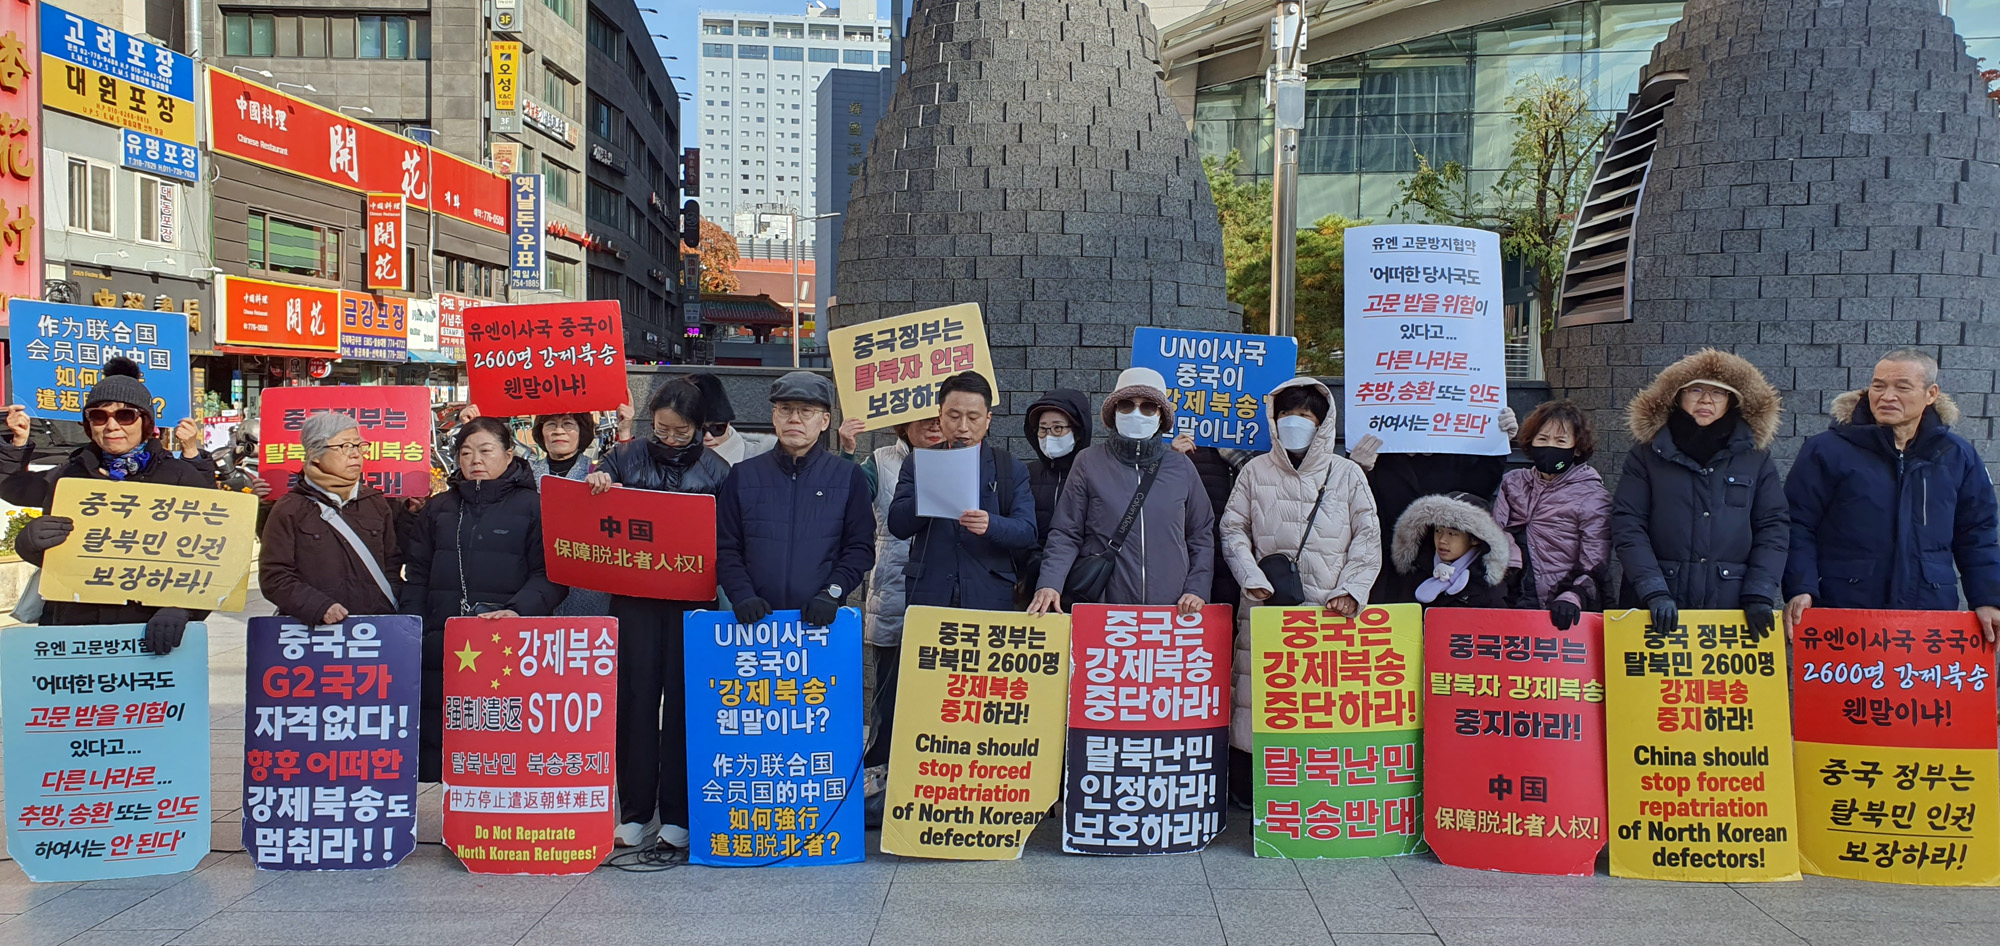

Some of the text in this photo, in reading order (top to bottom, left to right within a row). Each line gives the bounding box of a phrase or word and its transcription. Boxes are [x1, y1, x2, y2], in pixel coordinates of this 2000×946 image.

[500, 15, 510, 24] 3F
[64, 13, 174, 78] 고려포장
[498, 63, 512, 92] 오성
[65, 64, 175, 123] 대원포장
[236, 95, 288, 132] 中國料理
[500, 117, 509, 125] 3F
[126, 133, 196, 168] 유명포장
[237, 133, 289, 156] Chinese Restaurant
[374, 221, 397, 280] 開花
[1402, 236, 1476, 253] 고문방지협약
[513, 270, 539, 279] 제일사
[1423, 266, 1481, 285] 당사국도
[286, 297, 325, 336] 開花
[344, 298, 405, 331] 금강포장
[1362, 292, 1440, 313] 고문 받을
[38, 315, 157, 346] 作为联合国
[441, 312, 464, 328] 기념주
[468, 315, 614, 342] 유엔이사국 중국이
[26, 338, 171, 371] 会员国的中国
[473, 346, 533, 370] 2600명
[538, 342, 618, 368] 강제북송
[1159, 336, 1267, 367] UN이사국
[1375, 350, 1413, 371] 다른
[855, 343, 974, 392] 탈북자 인권
[1176, 362, 1244, 392] 중국이
[503, 373, 587, 400] 웬말이냐!
[1469, 383, 1500, 404] 인도
[1368, 414, 1429, 432] 하여서는
[78, 492, 230, 526] 중국 정부는
[82, 527, 227, 561] 탈북민 인권
[554, 538, 704, 574] 保障脱北者人权!
[84, 565, 213, 595] 보장하라!
[278, 622, 382, 660] 중국은
[938, 621, 1047, 650] 중국 정부는
[1104, 610, 1204, 648] 중국은
[1281, 607, 1392, 649] 중국은
[1800, 626, 1916, 655] 유엔이사국
[517, 627, 616, 677] 강제북송
[735, 649, 808, 677] 중국이
[917, 645, 1060, 675] 탈북민 2600명
[1449, 633, 1588, 664] 중국정부는
[1085, 647, 1214, 685] 강제북송
[1263, 647, 1406, 690] 강제북송
[1624, 651, 1775, 677] 탈북민 2600명
[1803, 660, 1989, 692] 2600명 강제북송
[97, 671, 176, 694] 당사국도
[947, 673, 1029, 701] 강제북송
[1430, 671, 1605, 703] 탈북자 강제북송
[1660, 679, 1749, 705] 강제북송
[25, 700, 186, 728] 고문 받을 위험이
[527, 691, 603, 734] STOP
[940, 699, 1030, 726] 중지하라!
[1083, 684, 1220, 722] 중단하라!
[1264, 688, 1416, 730] 중단하라!
[1842, 696, 1952, 728] 웬말이냐!
[716, 707, 830, 735] 웬말이냐?
[1454, 708, 1582, 742] 중지하라!
[1657, 706, 1753, 732] 중지하라!
[915, 732, 1040, 757] China should
[1085, 734, 1214, 774] 탈북난민
[1634, 745, 1769, 766] China should
[306, 748, 403, 781] 어떠한
[451, 751, 610, 775] 탈북난민 북송중지!
[712, 751, 834, 778] 作为联合国
[918, 759, 1032, 783] stop forced
[1263, 743, 1416, 787] 탈북난민
[1819, 758, 1975, 791] 중국 정부는
[41, 769, 86, 792] 다른
[702, 777, 847, 804] 会员国的中国
[914, 783, 1031, 805] repatriation
[1079, 773, 1217, 813] 인정하라!
[1641, 771, 1765, 797] stop forced
[157, 795, 200, 819] 인도
[247, 784, 411, 823] 강제북송도
[451, 789, 606, 810] 中方停止遣返朝鲜难民
[892, 802, 974, 825] of North
[1639, 797, 1768, 822] repatriation
[1264, 796, 1416, 840] 북송반대
[1434, 806, 1600, 841] 保障脱北者人权!
[1830, 798, 1976, 832] 탈북민 인권
[475, 824, 512, 840] Do Not
[919, 827, 1021, 849] defectors!
[1072, 811, 1219, 849] 보호하라!!
[1617, 820, 1788, 843] of North Korean
[34, 839, 107, 860] 하여서는
[457, 845, 597, 864] North Korean Refugees!
[1652, 847, 1765, 868] defectors!
[1838, 840, 1968, 871] 보장하라!
